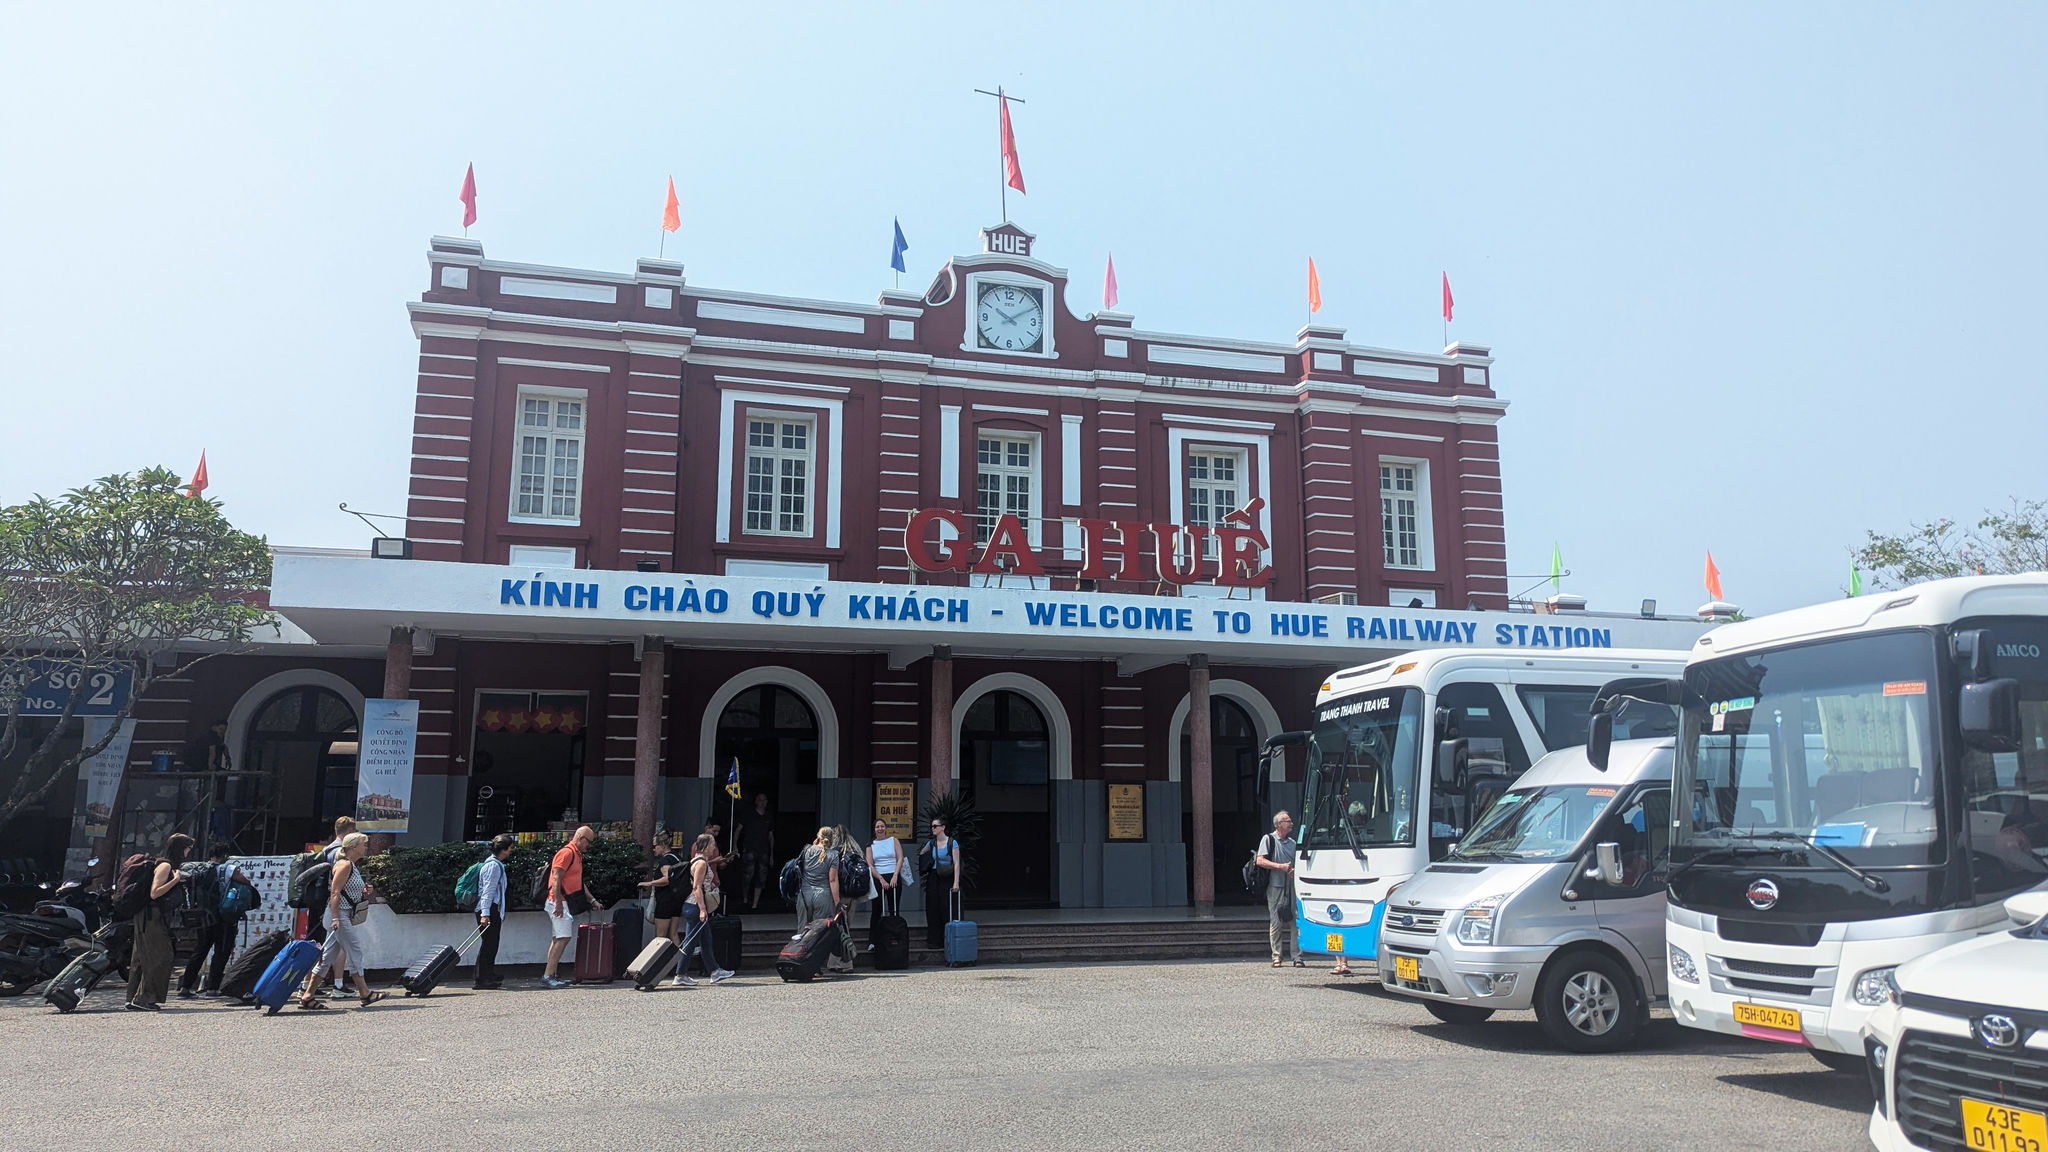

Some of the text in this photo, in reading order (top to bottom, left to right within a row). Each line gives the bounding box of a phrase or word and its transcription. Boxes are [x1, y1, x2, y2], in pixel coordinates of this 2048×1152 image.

[991, 233, 1027, 254] HUE
[1004, 291, 1015, 301] 12
[982, 313, 988, 322] 9
[1030, 318, 1037, 327] 3
[1006, 339, 1013, 348] 6
[904, 497, 1272, 588] GA HUẾ
[500, 572, 599, 609] KÍNH
[624, 579, 729, 614] CHÀO
[752, 586, 826, 619] QUÝ
[848, 590, 969, 623] KHÁCH
[1024, 602, 1193, 632] WELCOME
[1213, 610, 1251, 634] TO
[1271, 613, 1329, 638] HUE
[1346, 616, 1478, 644] RAILWAY
[1496, 623, 1611, 648] STATION
[1996, 644, 2040, 658] AMCO
[87, 673, 115, 705] 2
[1320, 697, 1390, 722] TRANG THANH TRAVEL
[881, 806, 891, 815] GA
[1986, 1107, 2022, 1133] 43E
